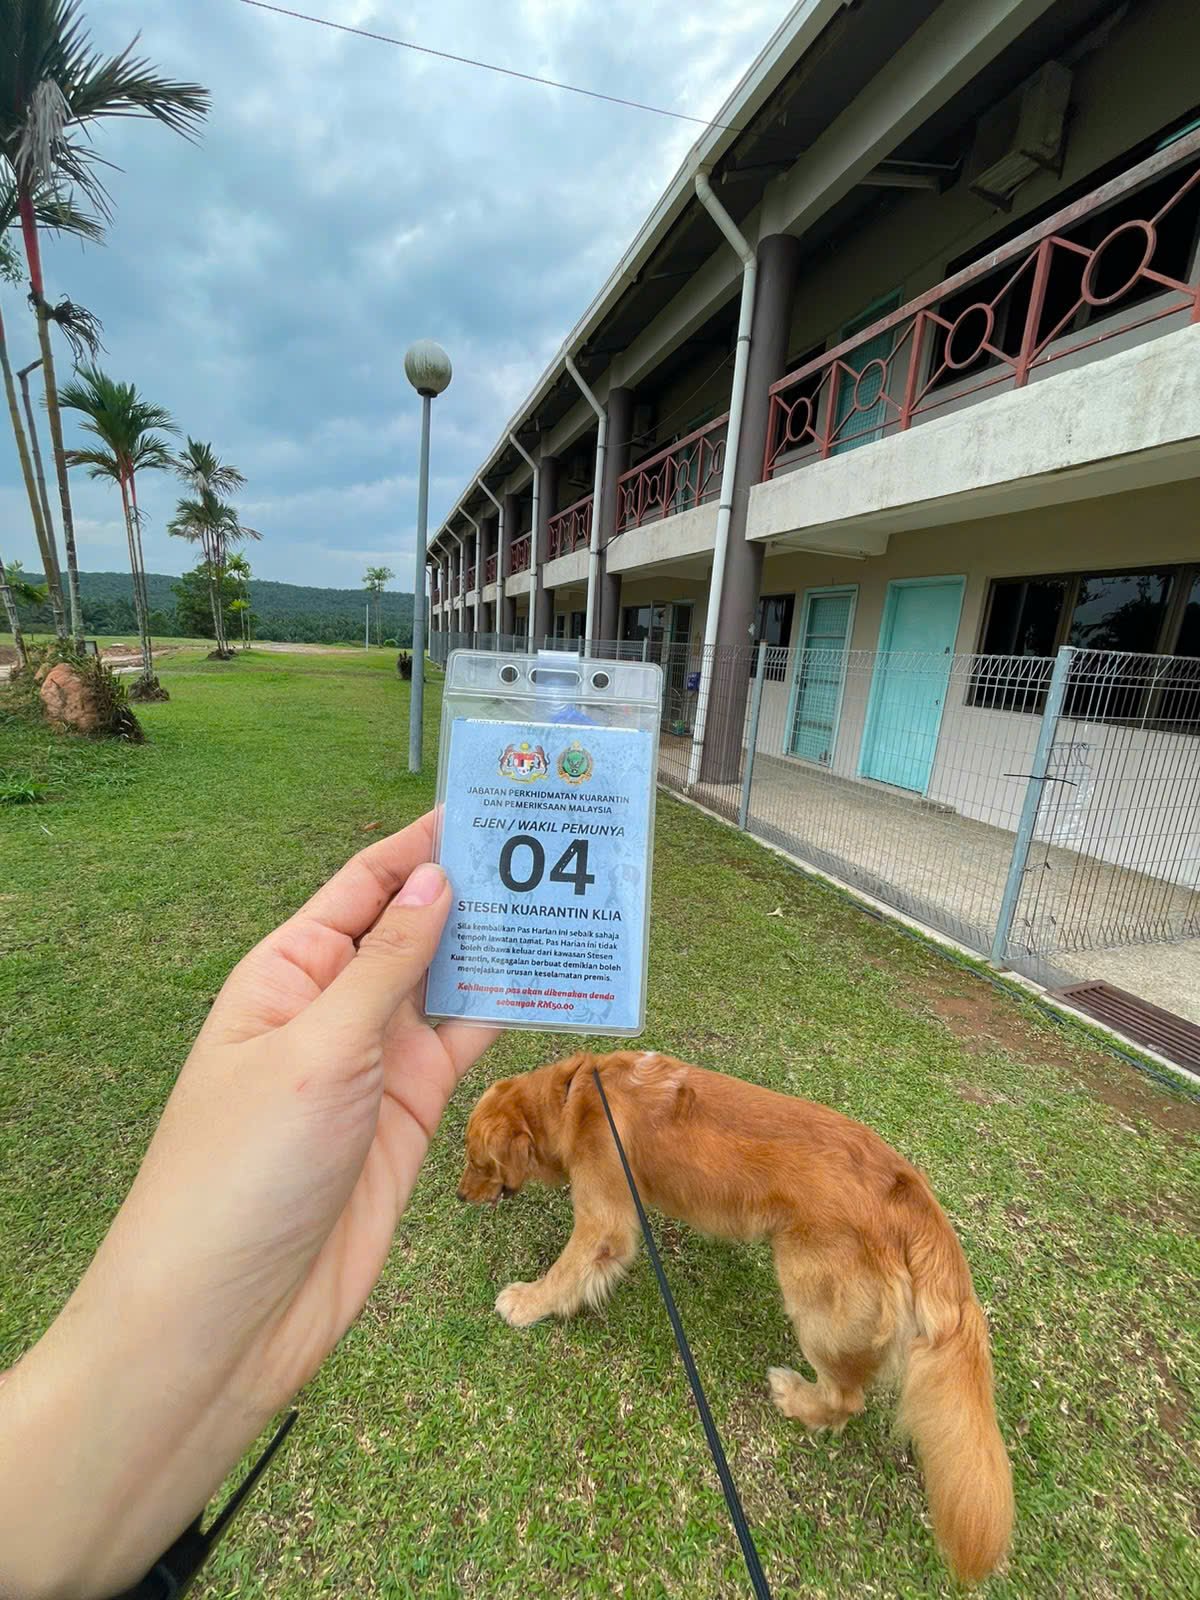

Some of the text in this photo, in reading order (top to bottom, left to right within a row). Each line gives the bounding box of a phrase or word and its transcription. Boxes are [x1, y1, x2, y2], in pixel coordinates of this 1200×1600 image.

[467, 787, 630, 803] JABATAN PERKHIDMATAN KUARANTIN
[483, 798, 612, 814] DAN PEMERIKSAAN MALAYSIA
[472, 817, 625, 837] EJEN / WAKIL PEMUNYA
[499, 834, 595, 896] 04
[458, 901, 622, 921] STESEN KUARANTIN KLIA
[517, 926, 531, 934] Pas
[532, 927, 557, 935] Harian
[569, 929, 593, 938] sebaik
[595, 931, 620, 941] sahaja
[457, 934, 487, 943] tempoh
[489, 935, 518, 943] lawatan
[519, 937, 544, 945] tamat.
[546, 938, 559, 946] Pas
[560, 939, 586, 948] Harian
[598, 942, 617, 950] tidak
[460, 943, 482, 951] boleh
[483, 945, 510, 953] dibawa
[512, 947, 535, 955] keluar
[554, 950, 586, 958] kawasan
[587, 951, 613, 960] Stesen
[491, 956, 529, 966] Kegagalan
[531, 959, 560, 967] berbuat
[562, 961, 598, 970] demikian
[599, 963, 621, 971] boleh
[506, 968, 533, 976] urusan
[534, 970, 582, 979] keselamatan
[505, 987, 521, 995] pas
[522, 987, 542, 996] akan
[589, 991, 615, 1000] denda
[537, 1000, 575, 1010] RM50.00
